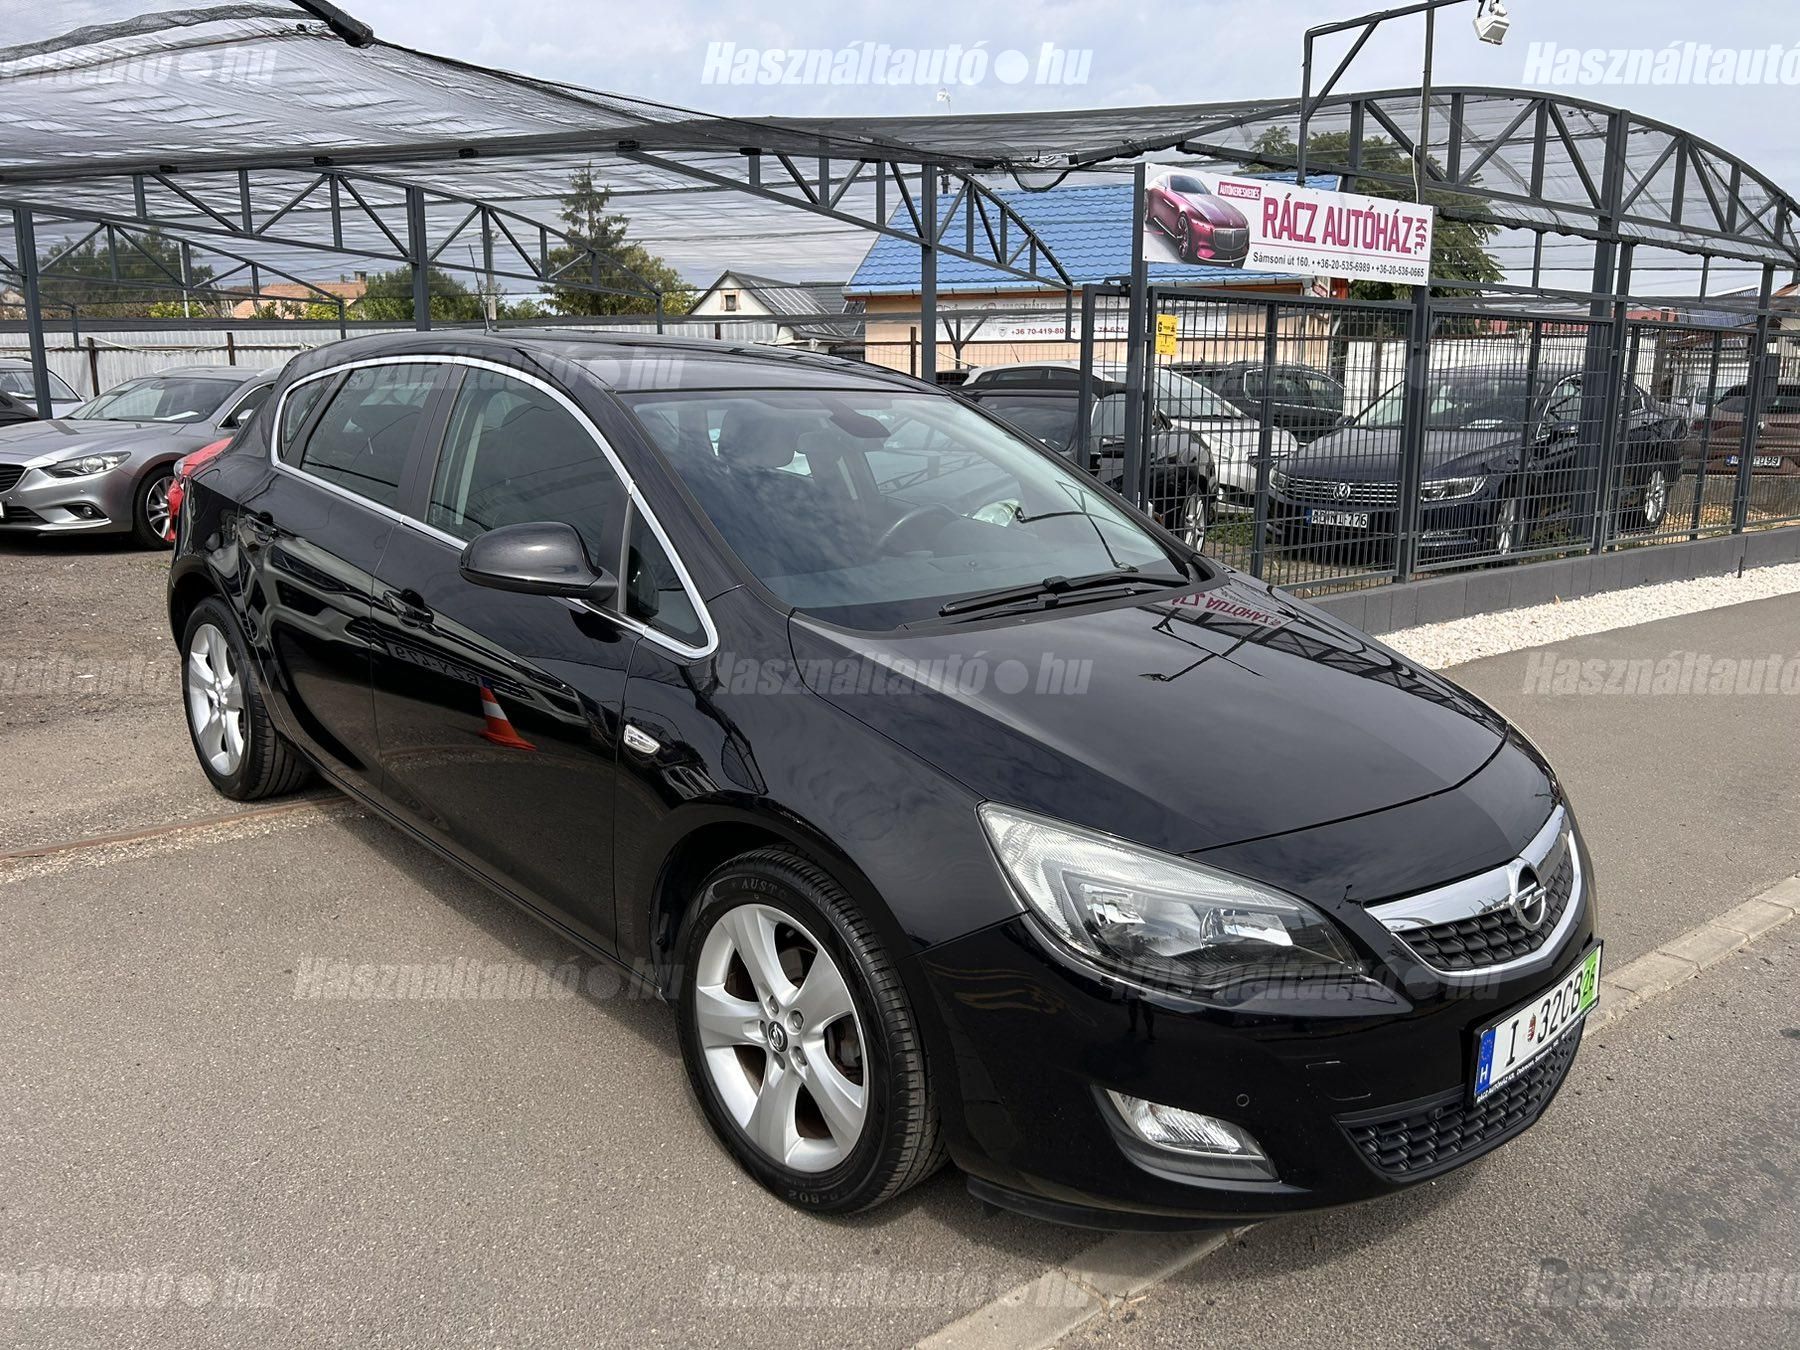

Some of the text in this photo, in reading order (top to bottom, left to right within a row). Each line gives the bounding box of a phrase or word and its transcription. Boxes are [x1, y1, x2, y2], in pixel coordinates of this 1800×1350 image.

[1262, 192, 1318, 244] RÁCZ
[1322, 204, 1413, 253] AUTÓHÁZ
[1253, 251, 1287, 265] Sámsoni
[1287, 254, 1295, 266] út
[1537, 969, 1583, 1044] 32CB
[1479, 1063, 1489, 1084] H
